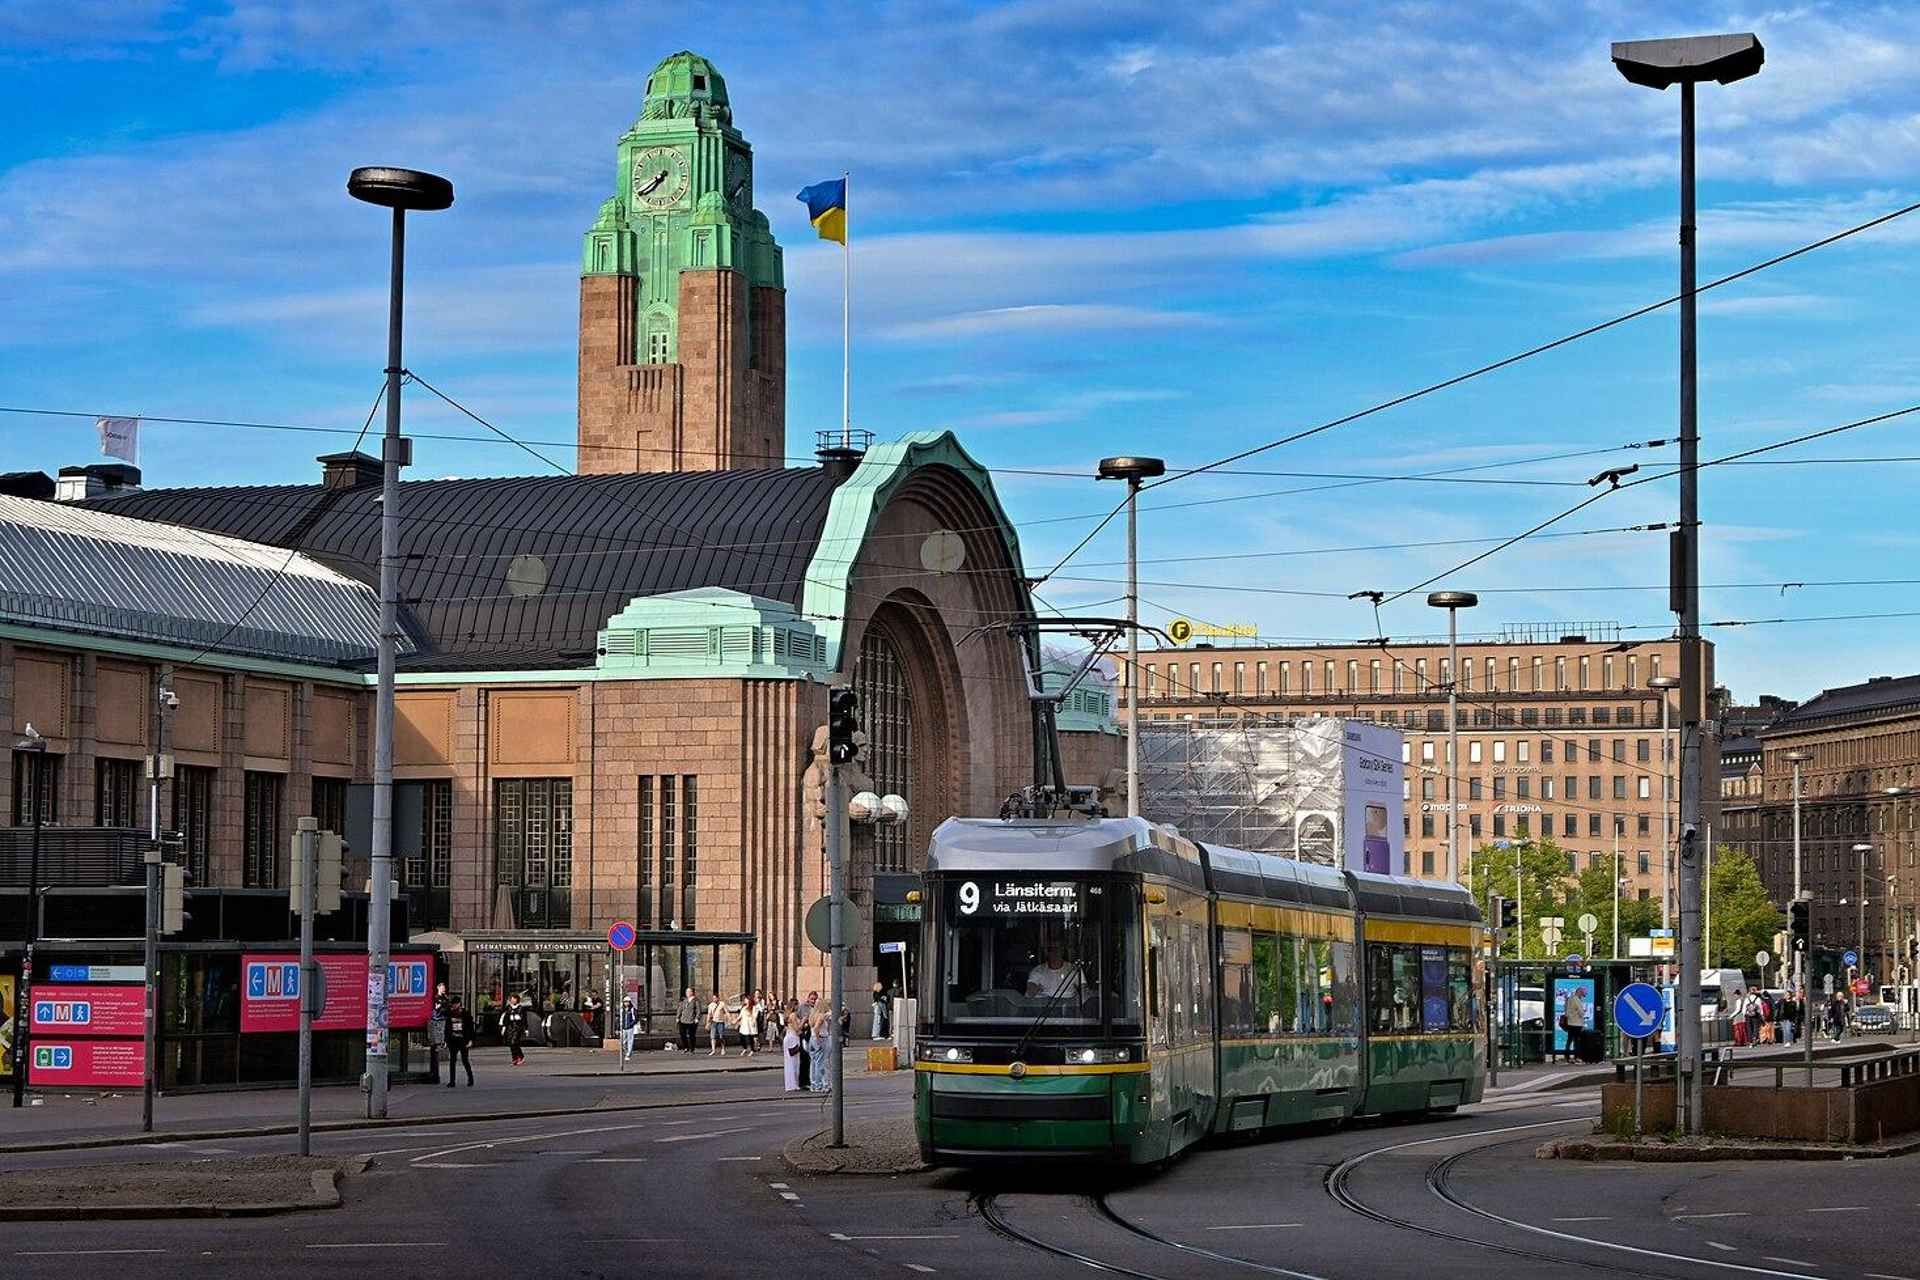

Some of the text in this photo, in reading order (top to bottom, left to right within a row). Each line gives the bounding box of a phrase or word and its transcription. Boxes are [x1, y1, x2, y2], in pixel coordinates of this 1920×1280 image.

[1430, 802, 1468, 813] mapox
[994, 882, 1077, 897] Länsiterm.
[959, 881, 980, 915] 9
[993, 900, 1078, 913] via Jätkäsaari
[267, 968, 281, 993] M
[398, 966, 409, 991] M
[55, 1005, 69, 1020] M
